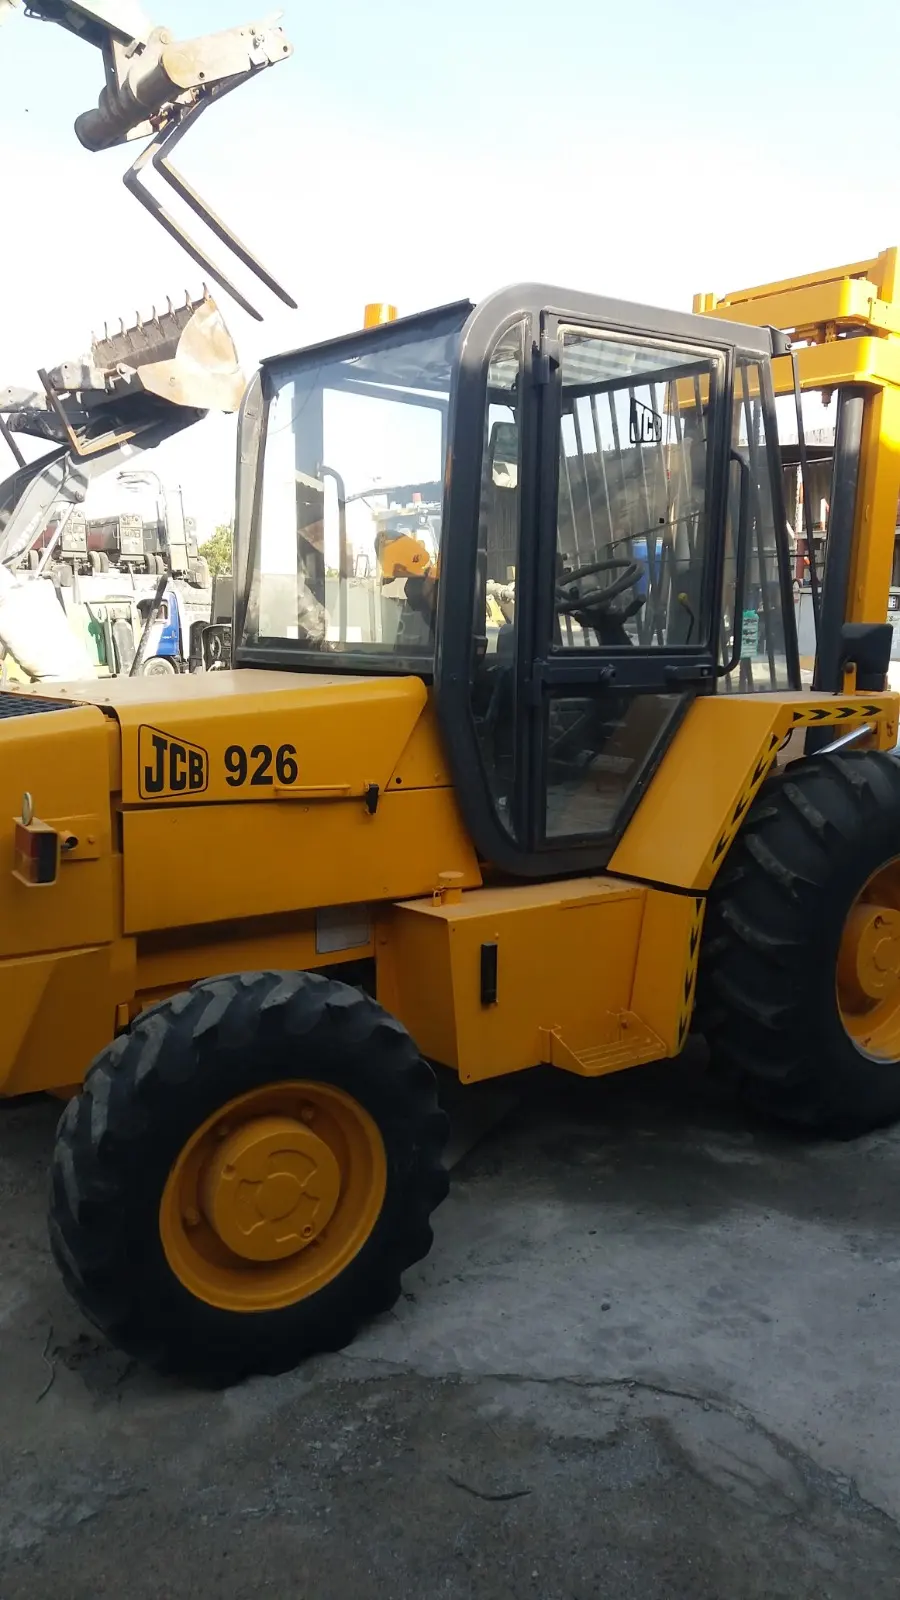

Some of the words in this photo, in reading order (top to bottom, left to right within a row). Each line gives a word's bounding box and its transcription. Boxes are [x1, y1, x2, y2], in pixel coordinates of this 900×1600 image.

[630, 398, 662, 442] JCB
[144, 733, 204, 793] JCB
[223, 743, 298, 787] 926
